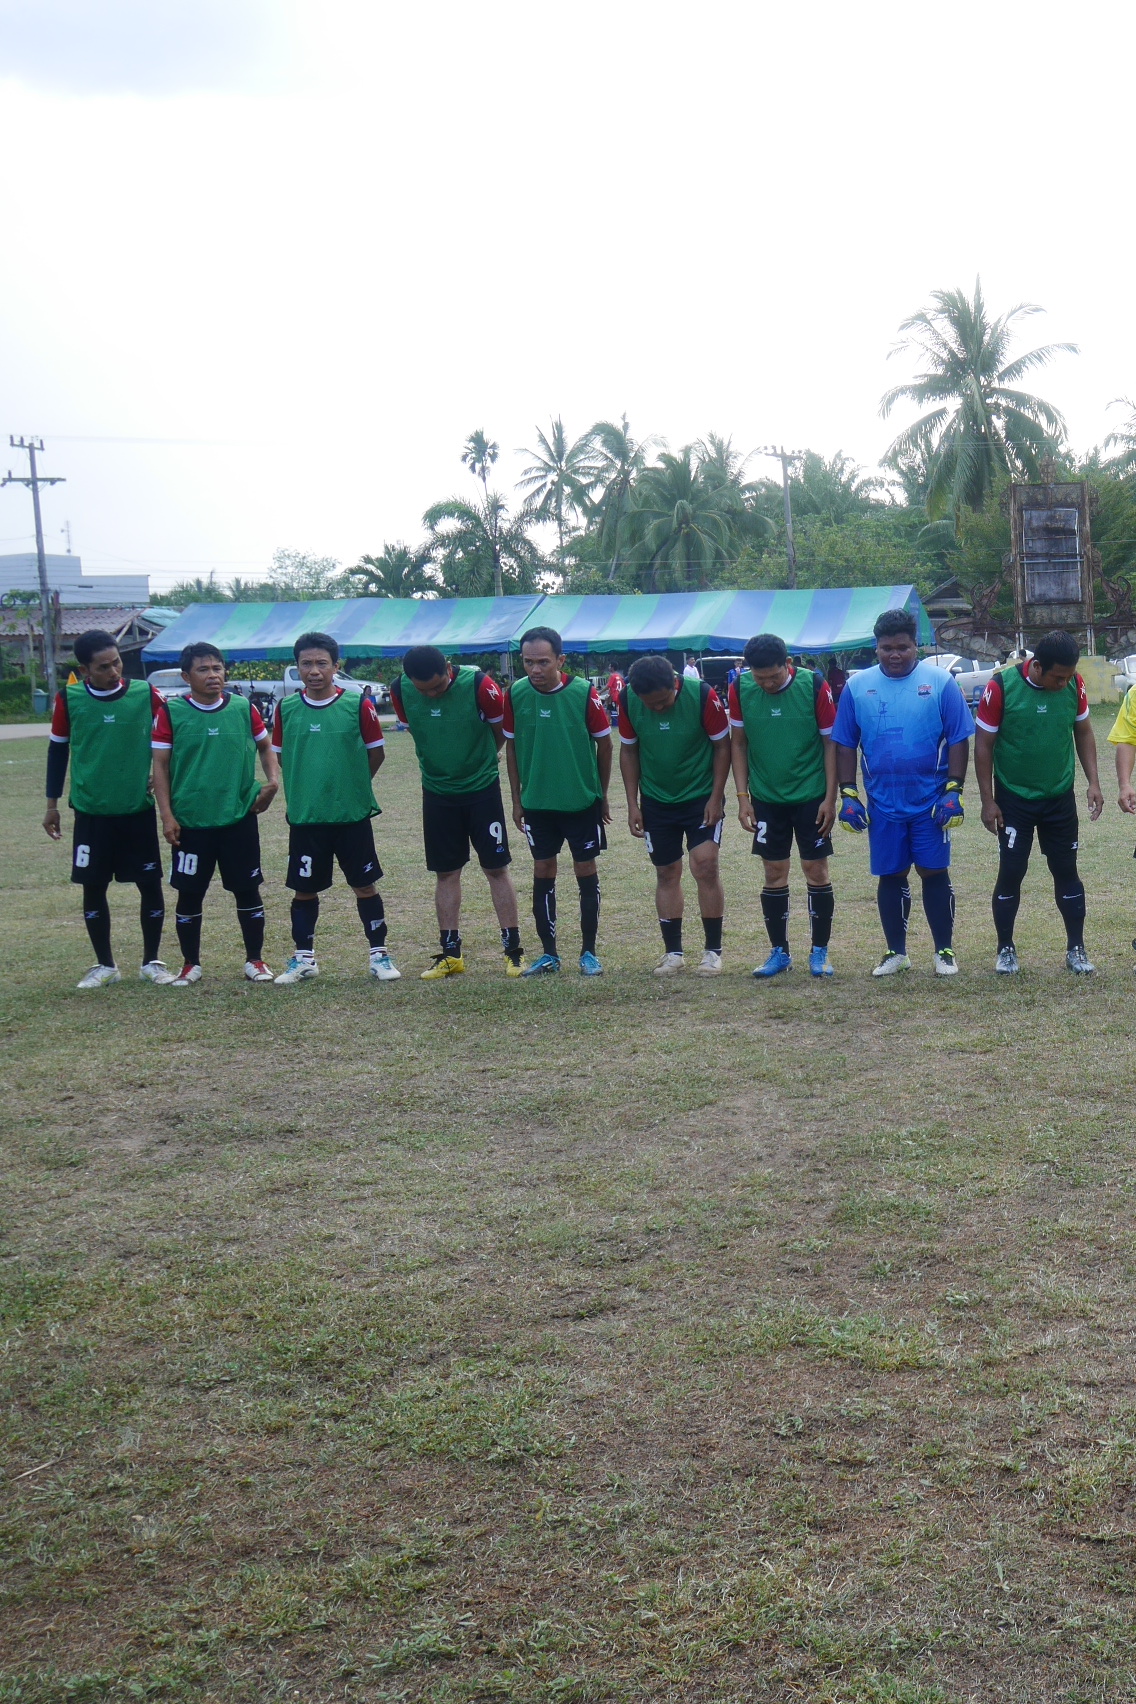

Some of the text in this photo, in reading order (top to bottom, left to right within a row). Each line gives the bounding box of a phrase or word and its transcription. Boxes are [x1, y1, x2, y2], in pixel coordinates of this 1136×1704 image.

[489, 821, 503, 845] 9
[756, 821, 767, 844] 2
[1005, 826, 1017, 849] 7
[75, 844, 91, 868] 6
[177, 850, 199, 876] 10
[299, 855, 313, 878] 3
